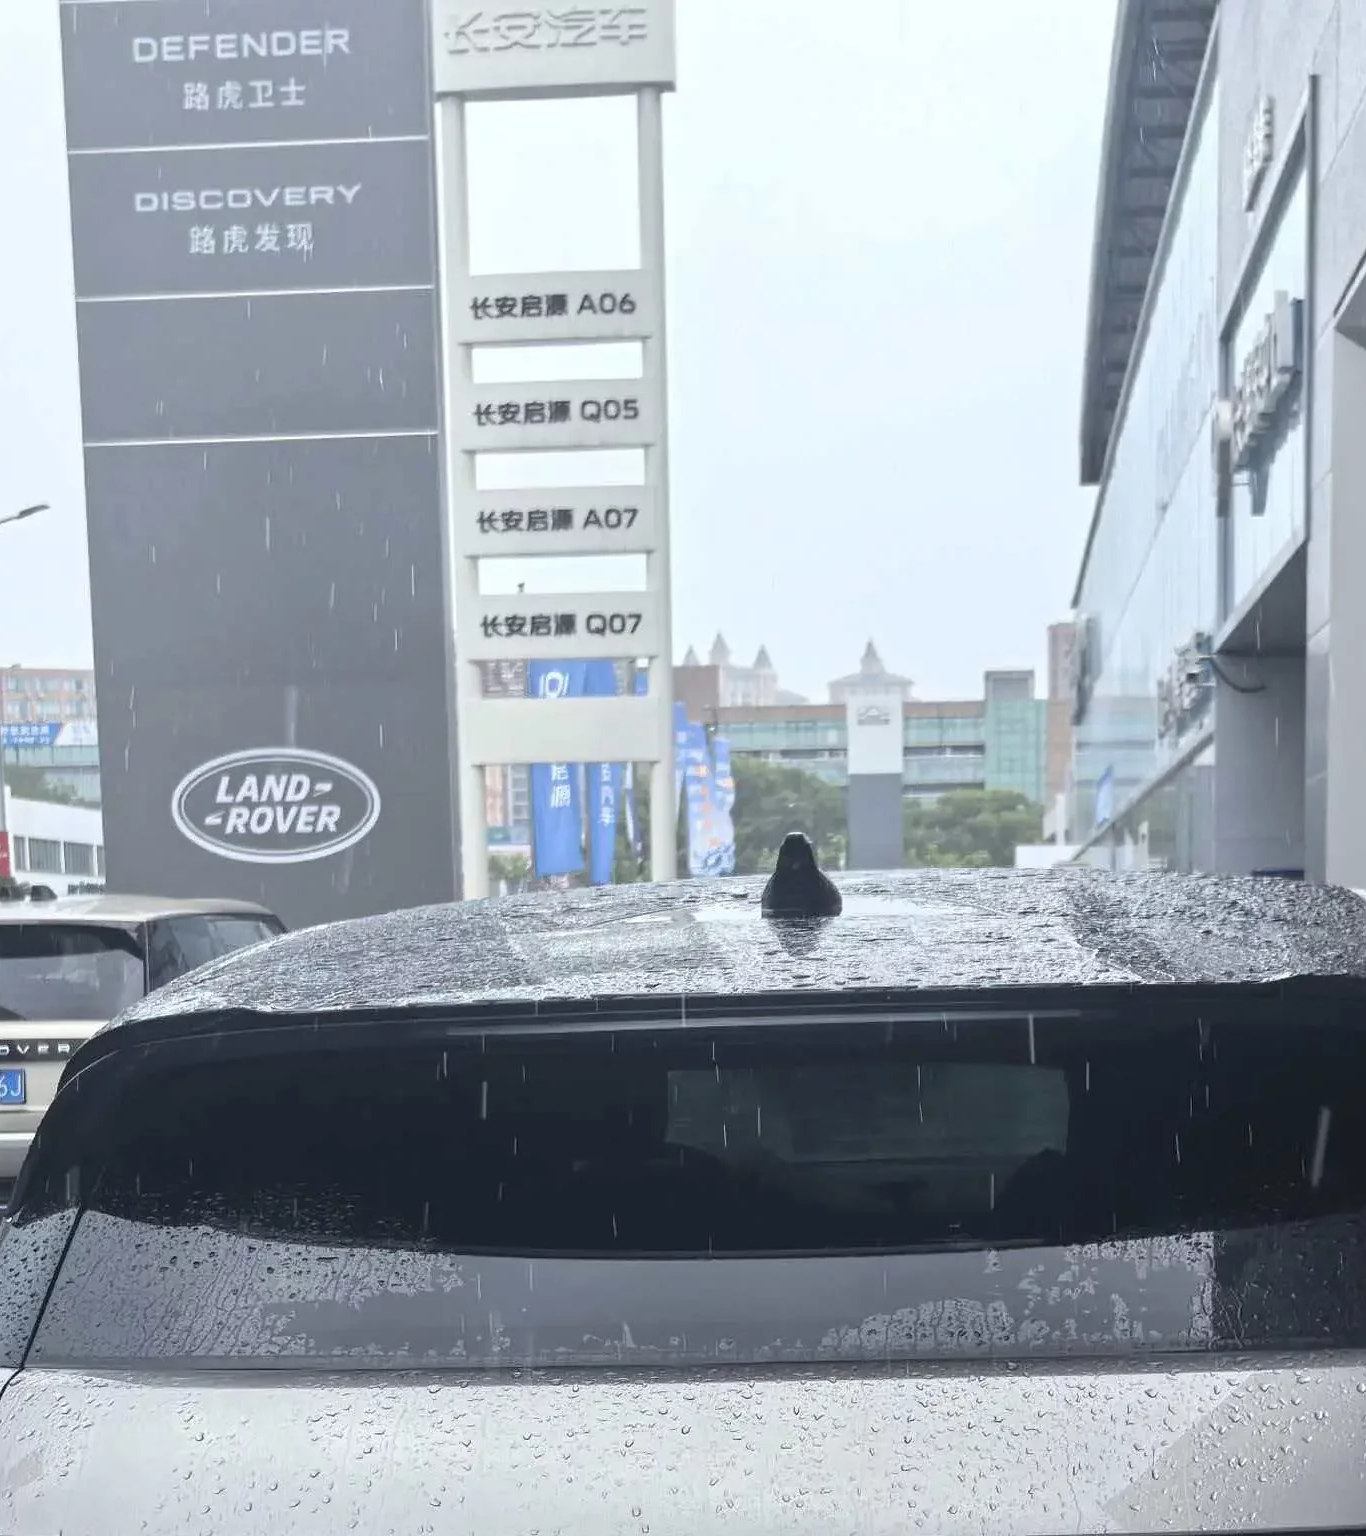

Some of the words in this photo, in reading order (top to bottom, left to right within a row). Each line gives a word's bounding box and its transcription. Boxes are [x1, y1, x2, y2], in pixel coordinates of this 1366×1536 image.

[132, 27, 352, 63] DEFENDER
[444, 5, 649, 55] 长安汽车
[183, 79, 307, 111] 路虎卫士
[134, 183, 363, 213] DISCOVERY
[188, 223, 315, 256] 路虎发现
[470, 294, 568, 320] 长安启源
[576, 293, 637, 316] A06
[474, 401, 571, 427] 长安启源
[580, 399, 640, 423] Q05
[476, 507, 574, 534] 长安启源
[583, 508, 638, 530] A07
[479, 613, 577, 639] 长安启源
[585, 612, 643, 637] Q07
